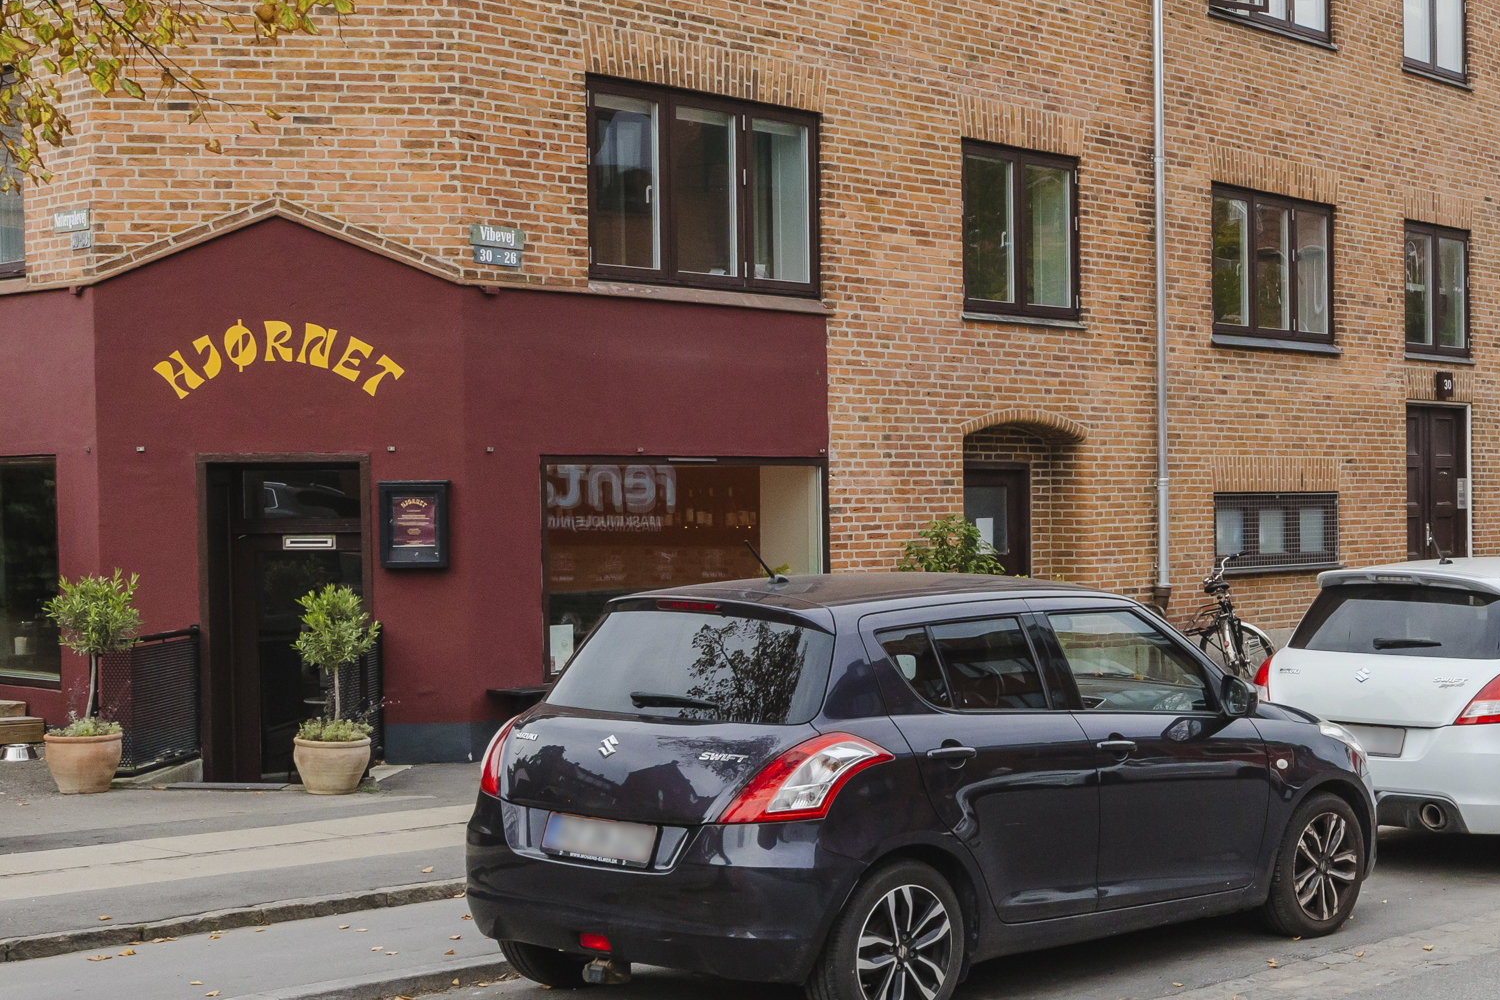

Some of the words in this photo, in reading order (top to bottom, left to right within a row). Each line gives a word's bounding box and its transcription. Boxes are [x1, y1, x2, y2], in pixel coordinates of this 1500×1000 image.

[480, 225, 515, 247] Vibevej
[480, 248, 493, 262] 30
[504, 251, 517, 265] 26
[153, 319, 405, 400] HJØRNET
[1443, 379, 1453, 390] 30
[698, 751, 749, 763] SWIFT
